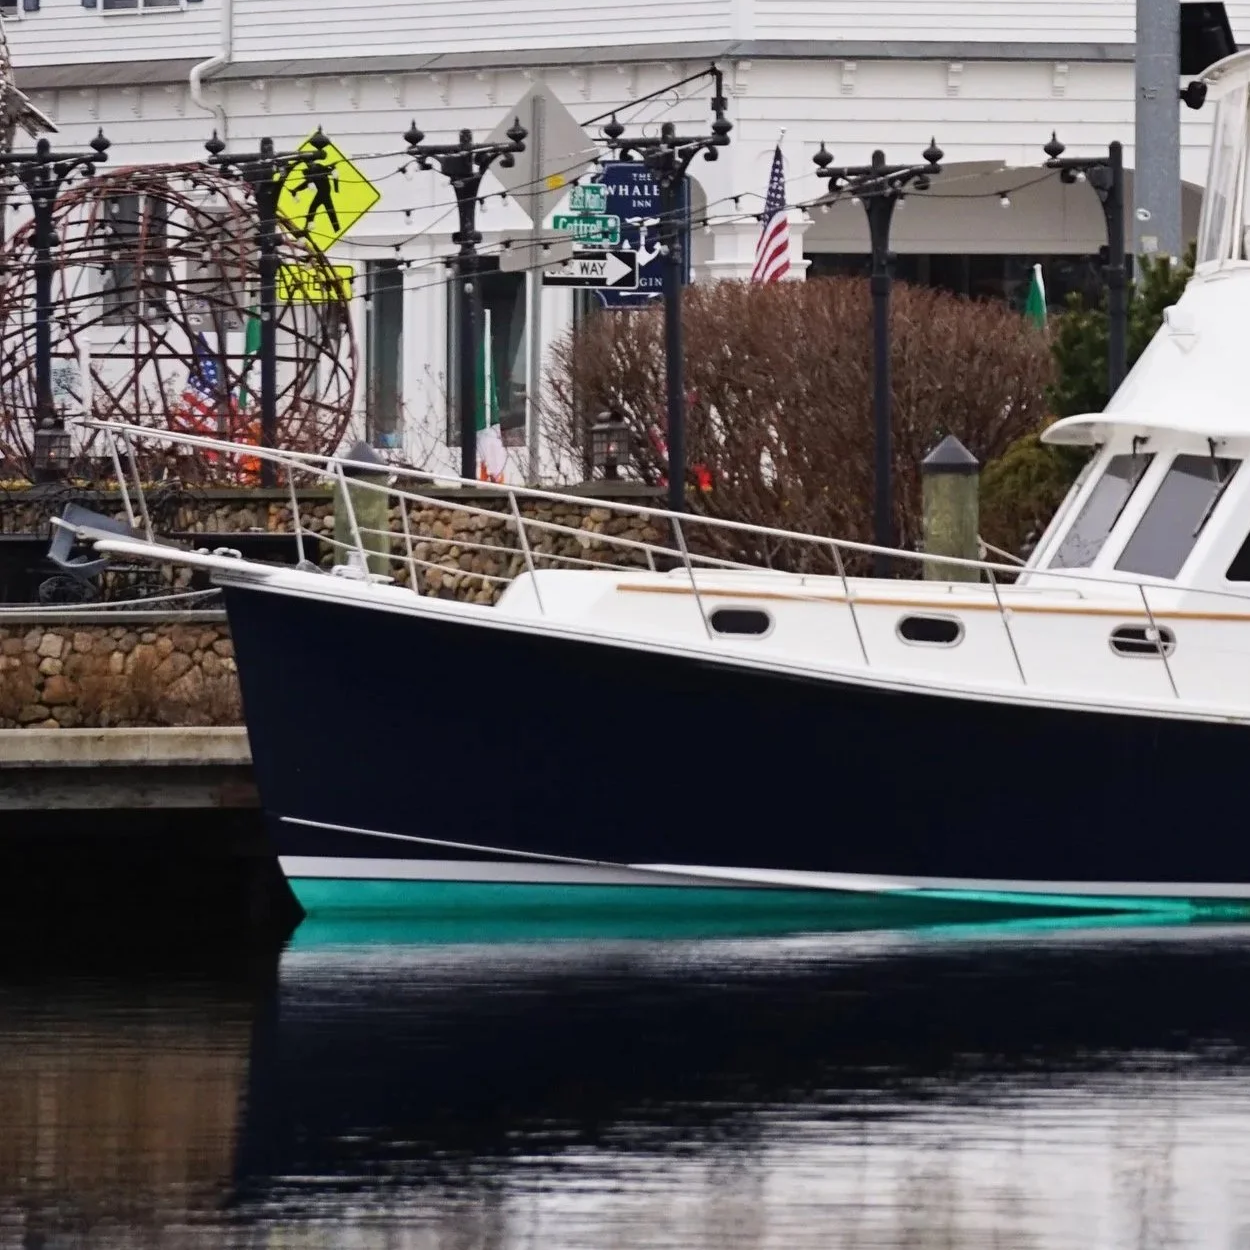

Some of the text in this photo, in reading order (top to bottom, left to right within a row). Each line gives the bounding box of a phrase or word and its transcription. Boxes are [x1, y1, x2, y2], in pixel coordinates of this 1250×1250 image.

[606, 184, 660, 196] WHALE
[632, 200, 652, 208] INN
[580, 262, 606, 275] WAY
